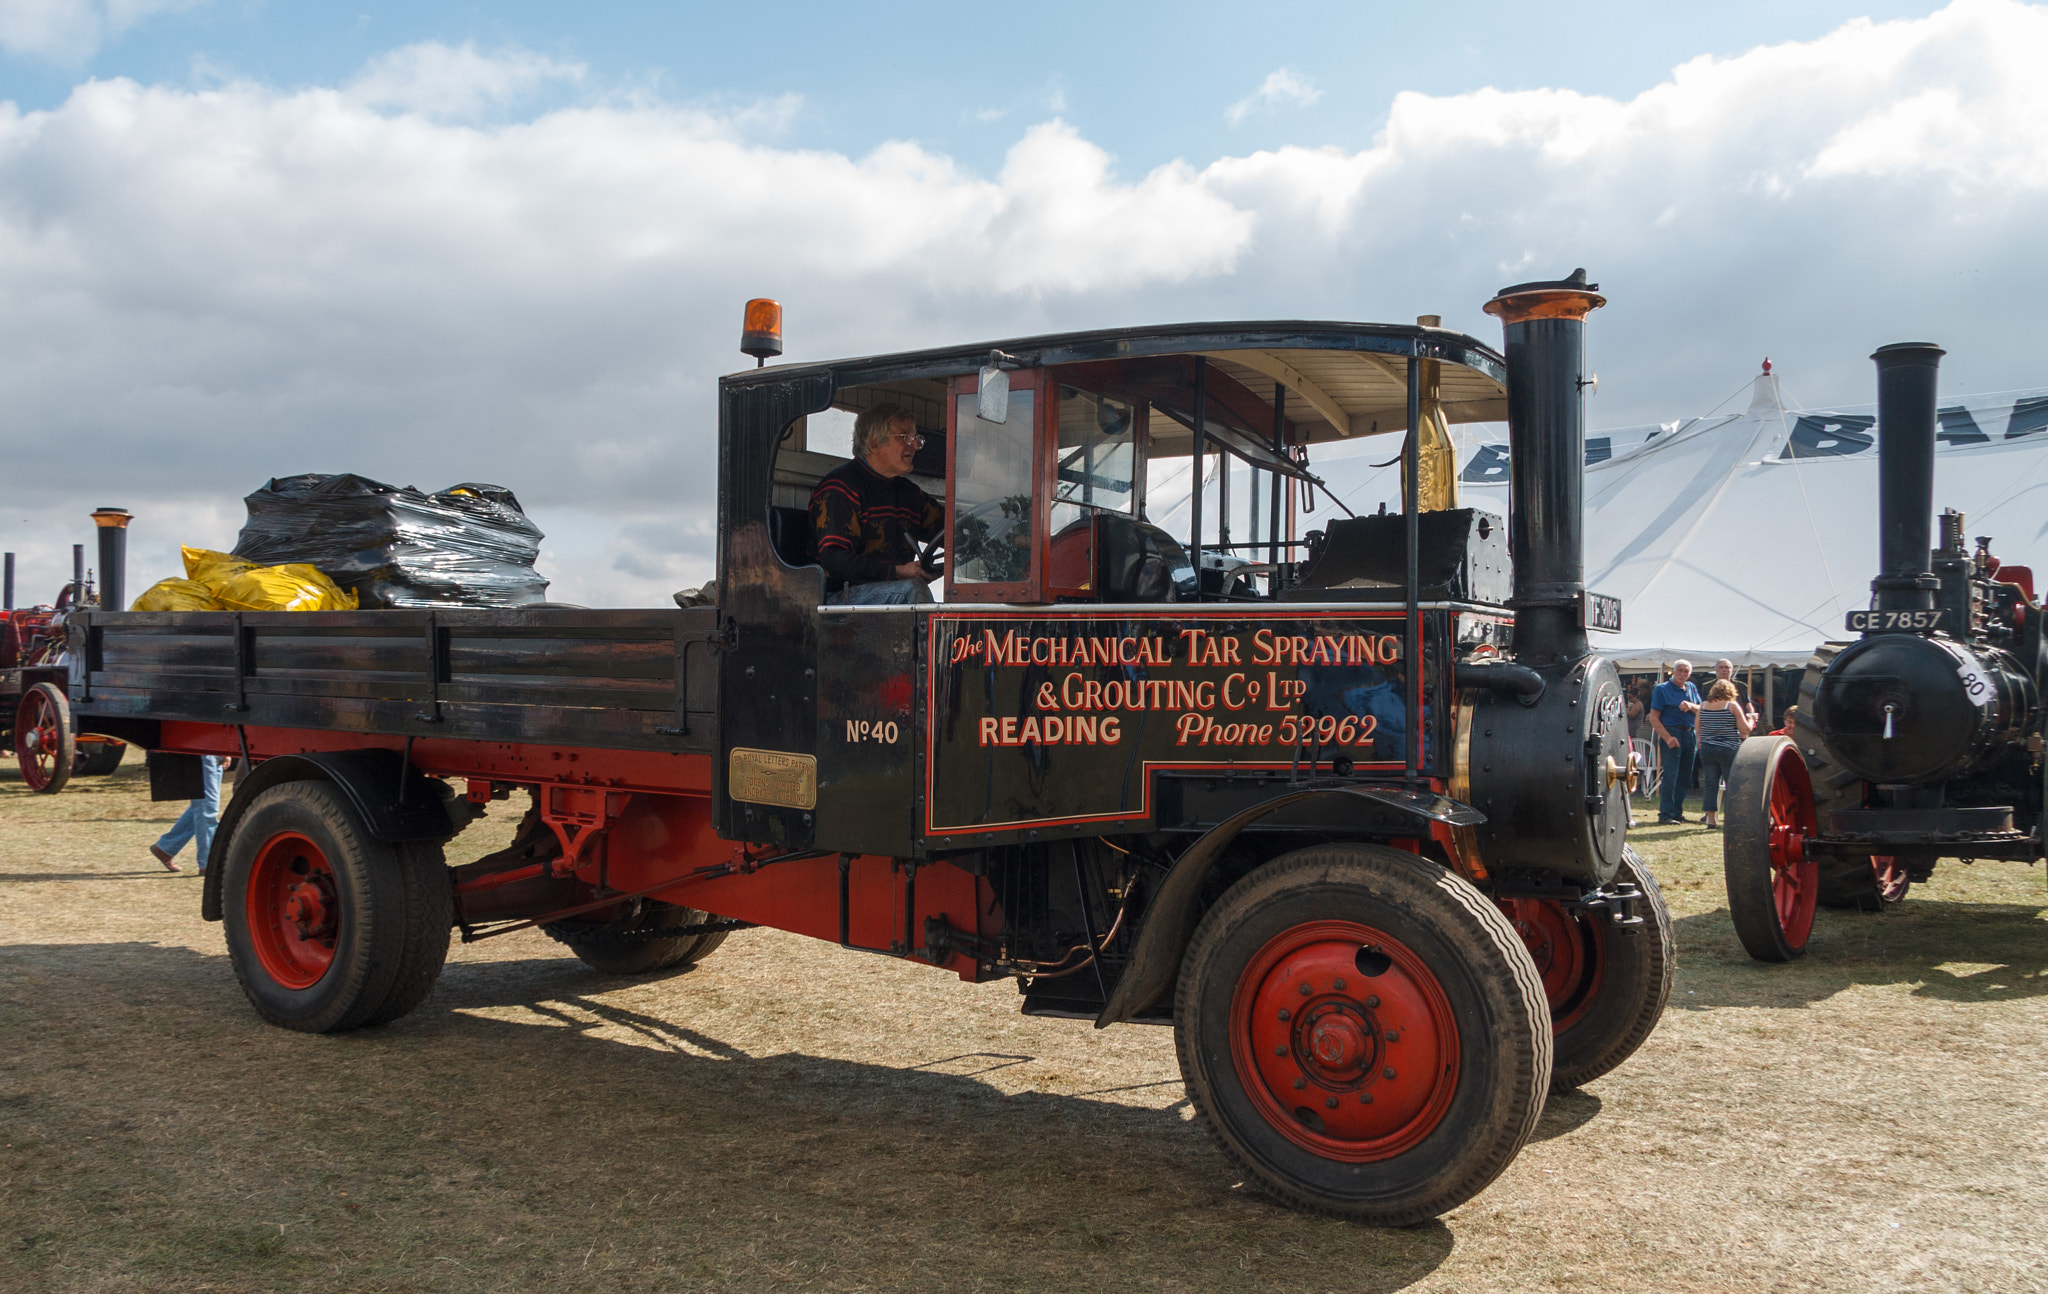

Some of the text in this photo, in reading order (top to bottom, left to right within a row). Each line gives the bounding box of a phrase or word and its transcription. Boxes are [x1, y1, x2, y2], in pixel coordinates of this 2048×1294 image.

[1601, 598, 1618, 628] 3106
[1852, 611, 1942, 629] CE 7857
[951, 628, 1398, 666] The MECHANICAL TAR SPRAYING
[1061, 672, 1215, 711] GROUTING
[1962, 673, 1985, 695] 80
[979, 716, 1121, 747] READING
[1175, 712, 1378, 746] Phone 52962
[744, 754, 762, 764] ROYAL
[764, 754, 789, 767] LETTERS
